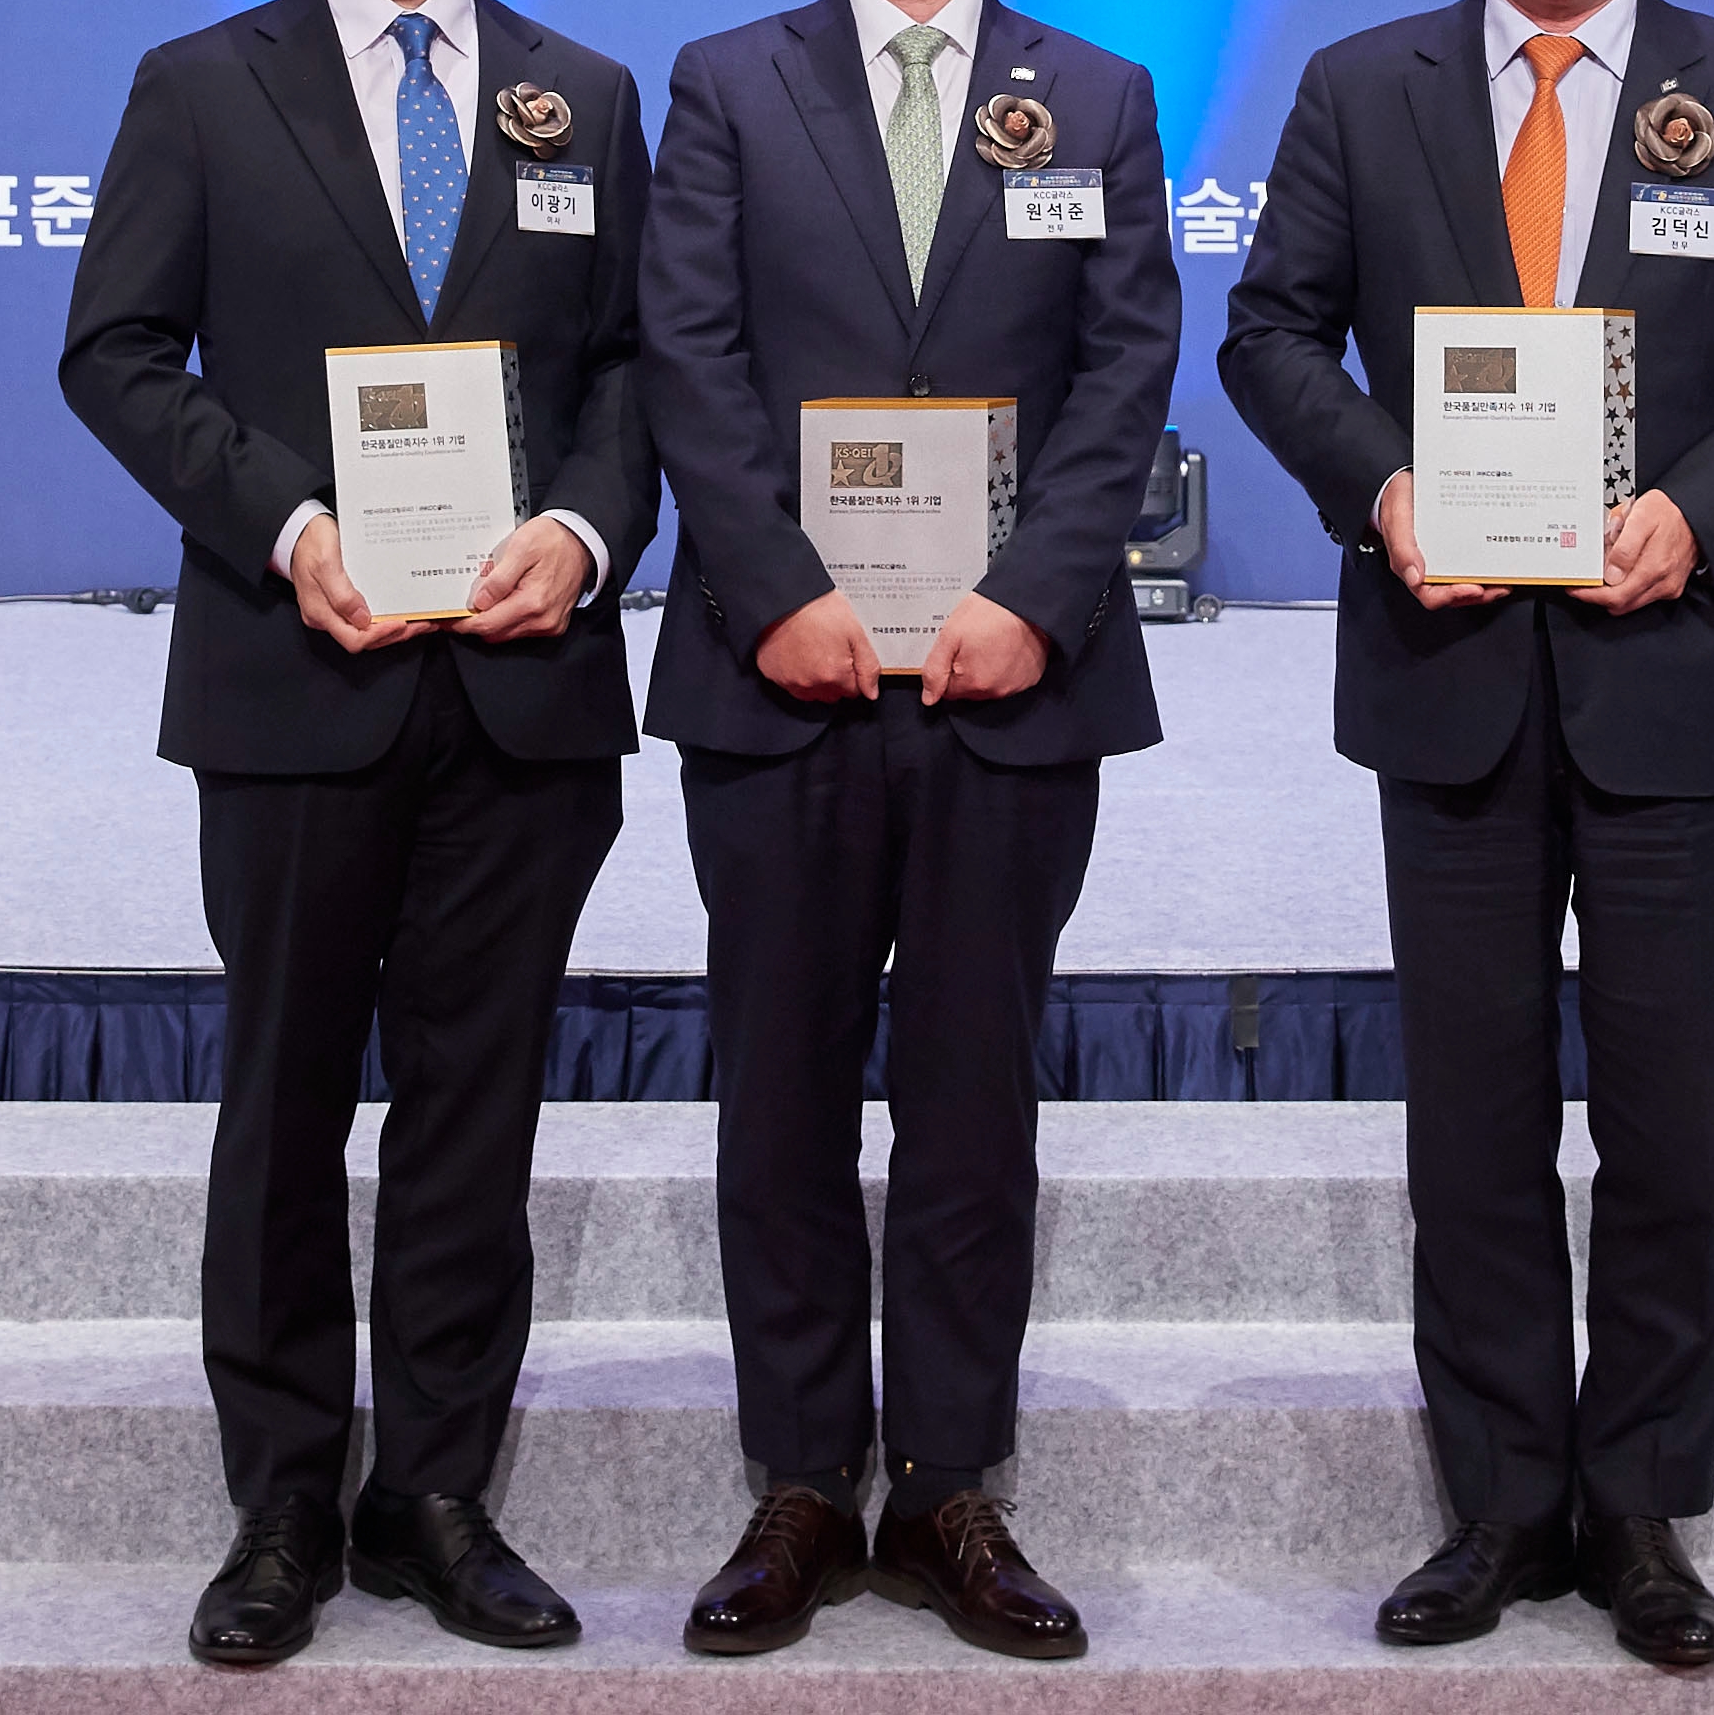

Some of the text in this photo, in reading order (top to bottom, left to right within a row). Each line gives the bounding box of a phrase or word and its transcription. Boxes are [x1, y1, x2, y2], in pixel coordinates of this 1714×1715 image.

[531, 193, 576, 215] 이광기
[1033, 191, 1074, 200] KCC글라스
[1026, 203, 1084, 221] 원석준
[1651, 217, 1709, 240] 김덕신
